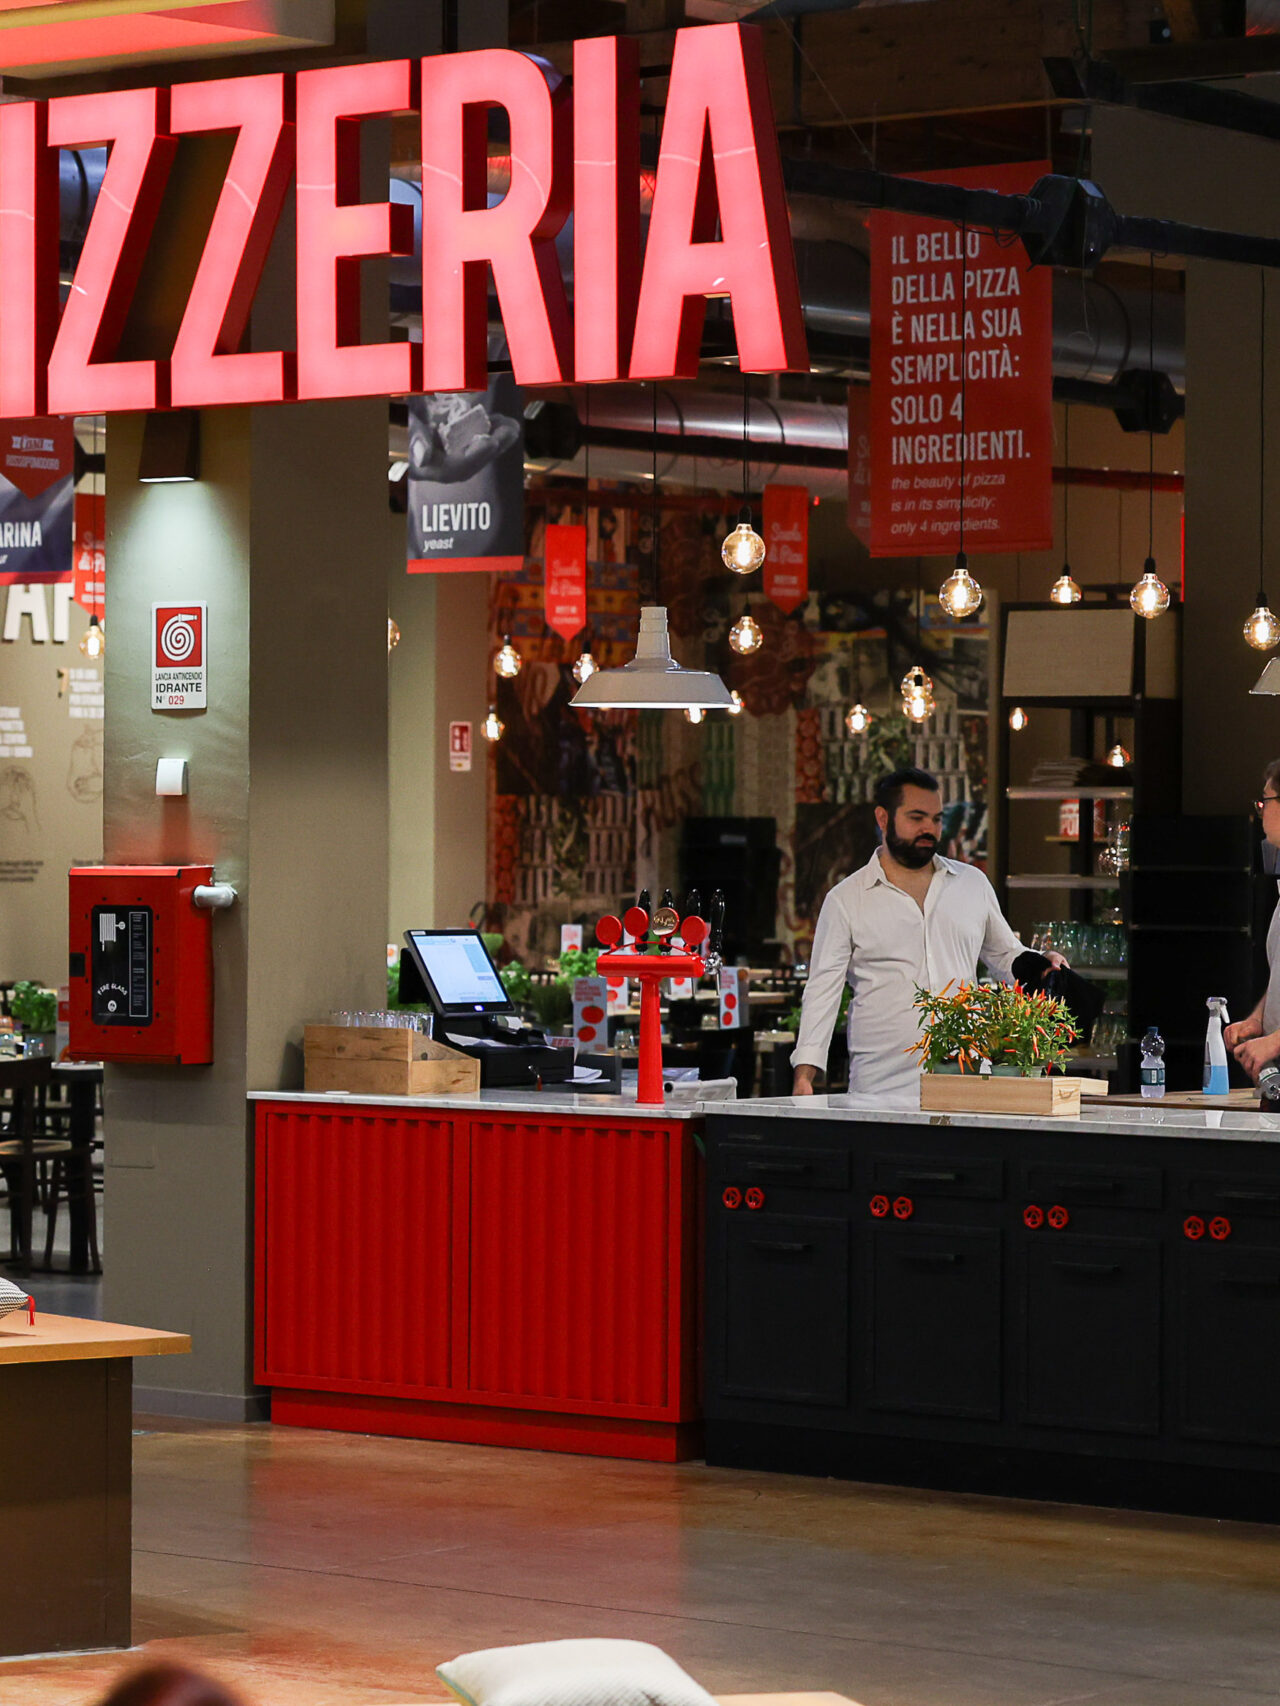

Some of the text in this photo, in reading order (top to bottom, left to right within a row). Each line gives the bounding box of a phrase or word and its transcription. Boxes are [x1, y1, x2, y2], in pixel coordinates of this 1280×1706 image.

[891, 229, 981, 265] IL BELLO
[891, 266, 1021, 306] DELLA PIZZA
[891, 308, 1022, 346] È NELLA SUA
[890, 392, 963, 425] SOLO 4
[891, 429, 1031, 466] INGREDIENTI.
[891, 472, 1006, 491] the beauty of pizza
[891, 496, 997, 514] is in its simplicity:
[422, 502, 491, 533] LIEVITO
[891, 516, 1001, 536] only 4 ingredients.
[422, 535, 455, 553] yeast
[155, 671, 203, 681] LANCIA ANTINCENDIO
[155, 682, 202, 693] IDRANTE
[168, 695, 185, 705] 029
[97, 982, 128, 996] FIRE GLASS
